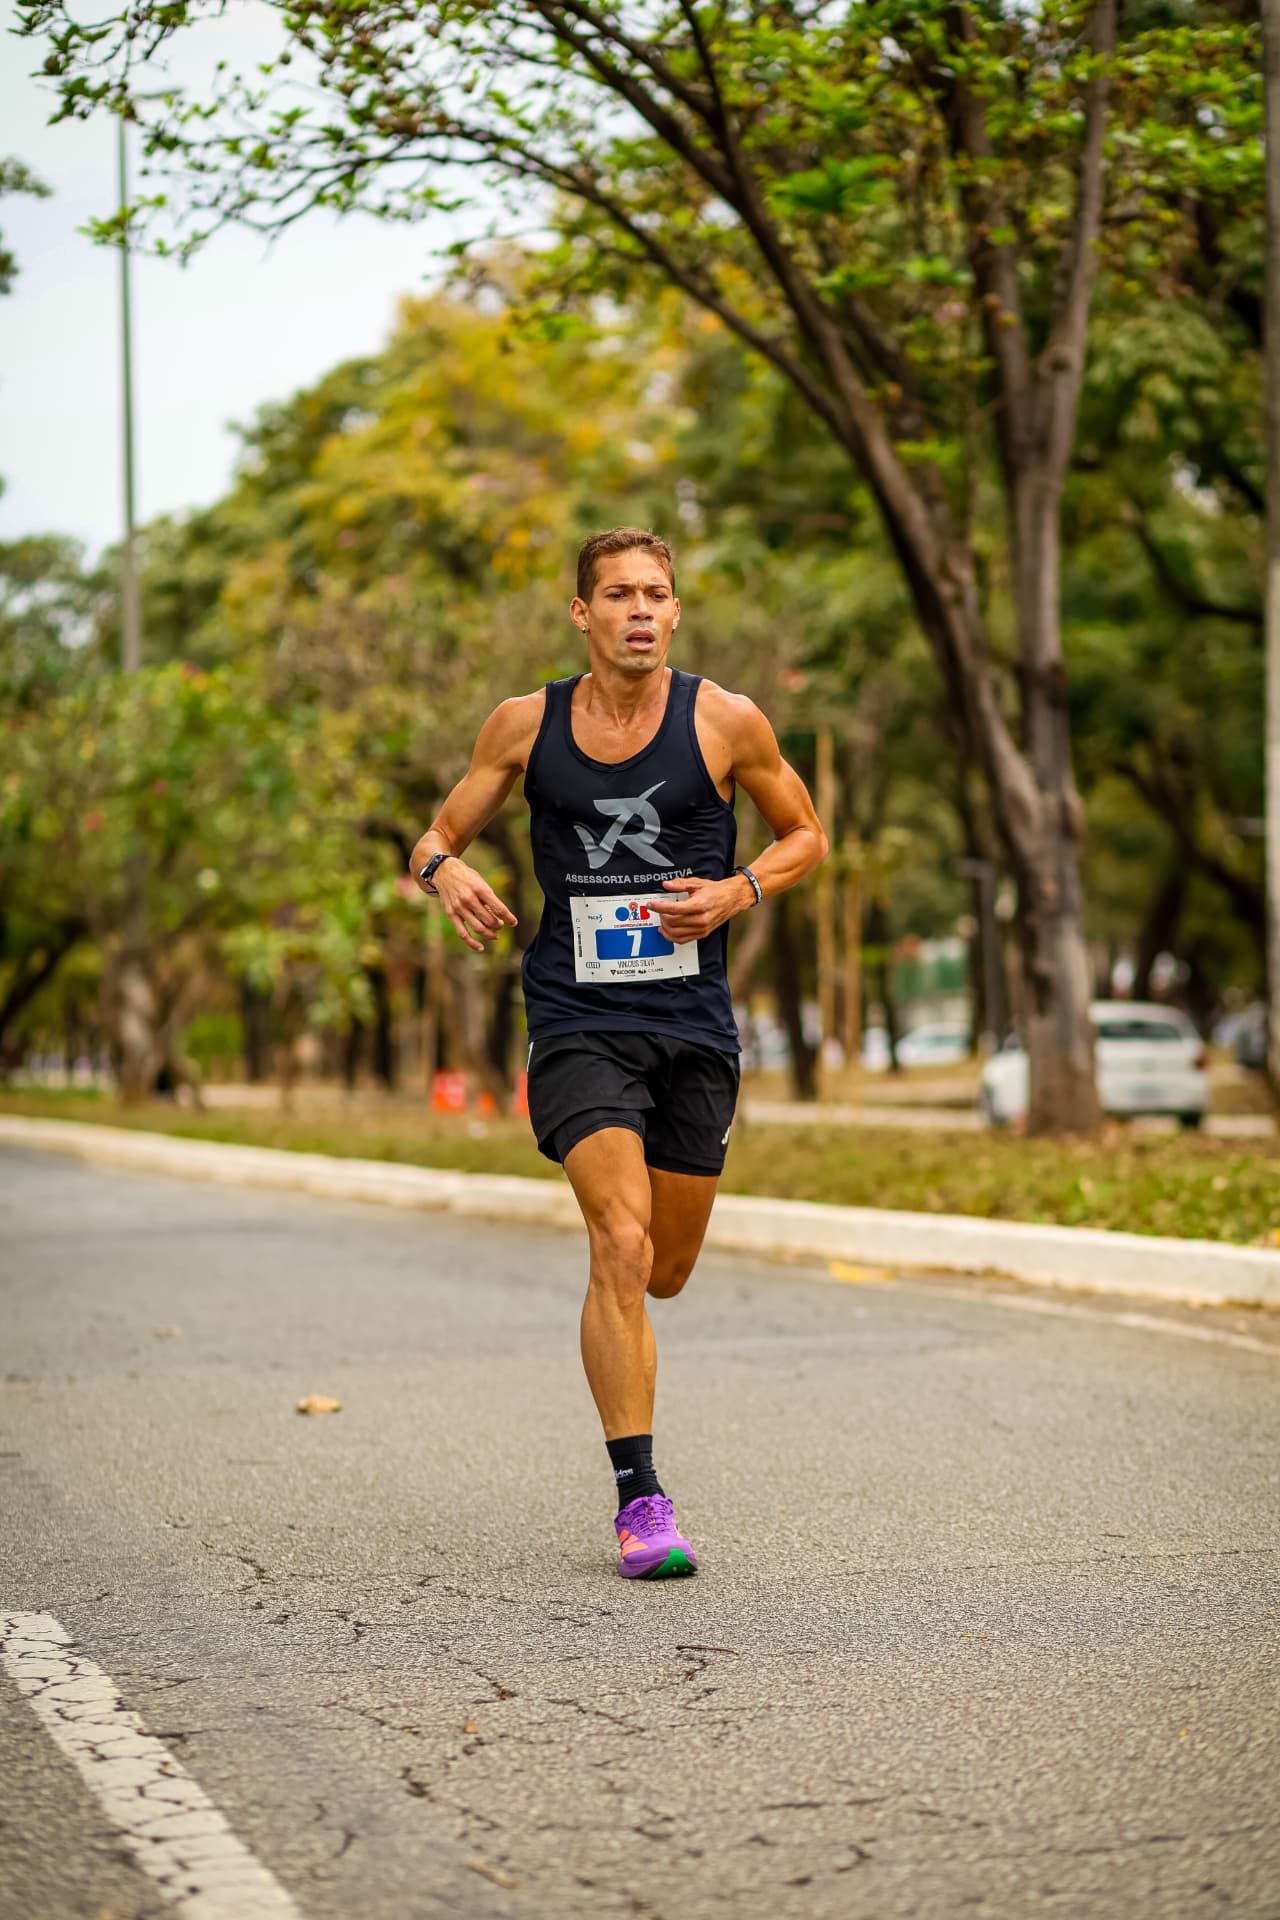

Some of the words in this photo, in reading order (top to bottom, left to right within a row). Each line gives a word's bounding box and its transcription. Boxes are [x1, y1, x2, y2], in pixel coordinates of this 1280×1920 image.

[565, 873, 632, 884] ASSESSORIA
[633, 867, 693, 883] ESPORTIVA
[627, 929, 642, 957] 7
